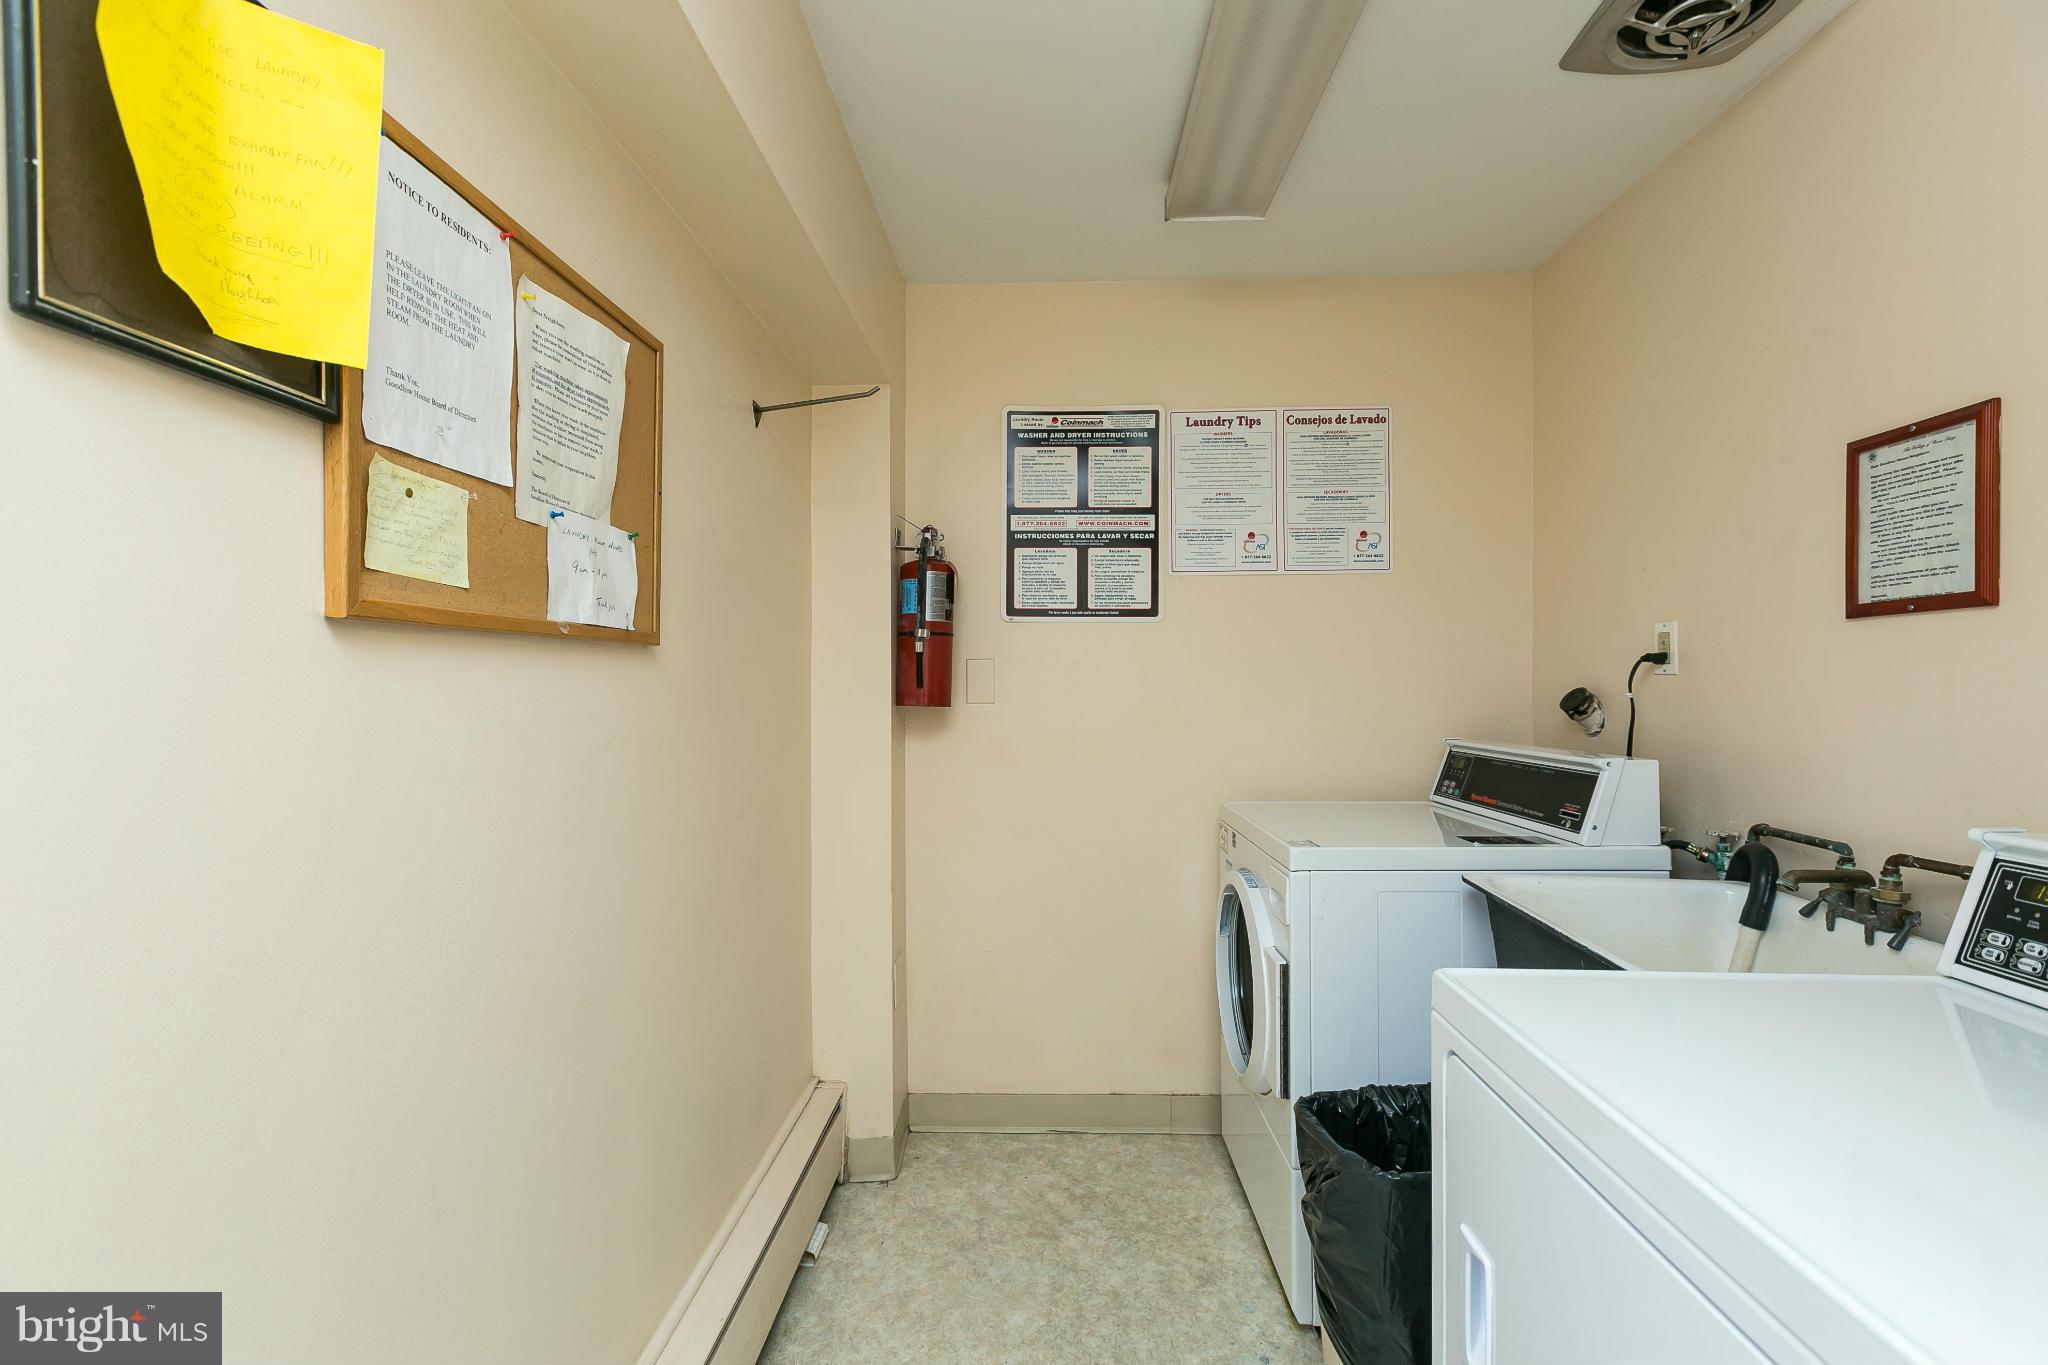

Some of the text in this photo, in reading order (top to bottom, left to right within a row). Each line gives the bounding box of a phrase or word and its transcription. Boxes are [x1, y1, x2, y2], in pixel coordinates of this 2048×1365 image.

[388, 170, 491, 255] NOTICE TO RESIDENTS:
[385, 365, 405, 381] Thank
[1186, 416, 1261, 429] Laundry Tips
[1286, 414, 1386, 427] Consejos de Lavado
